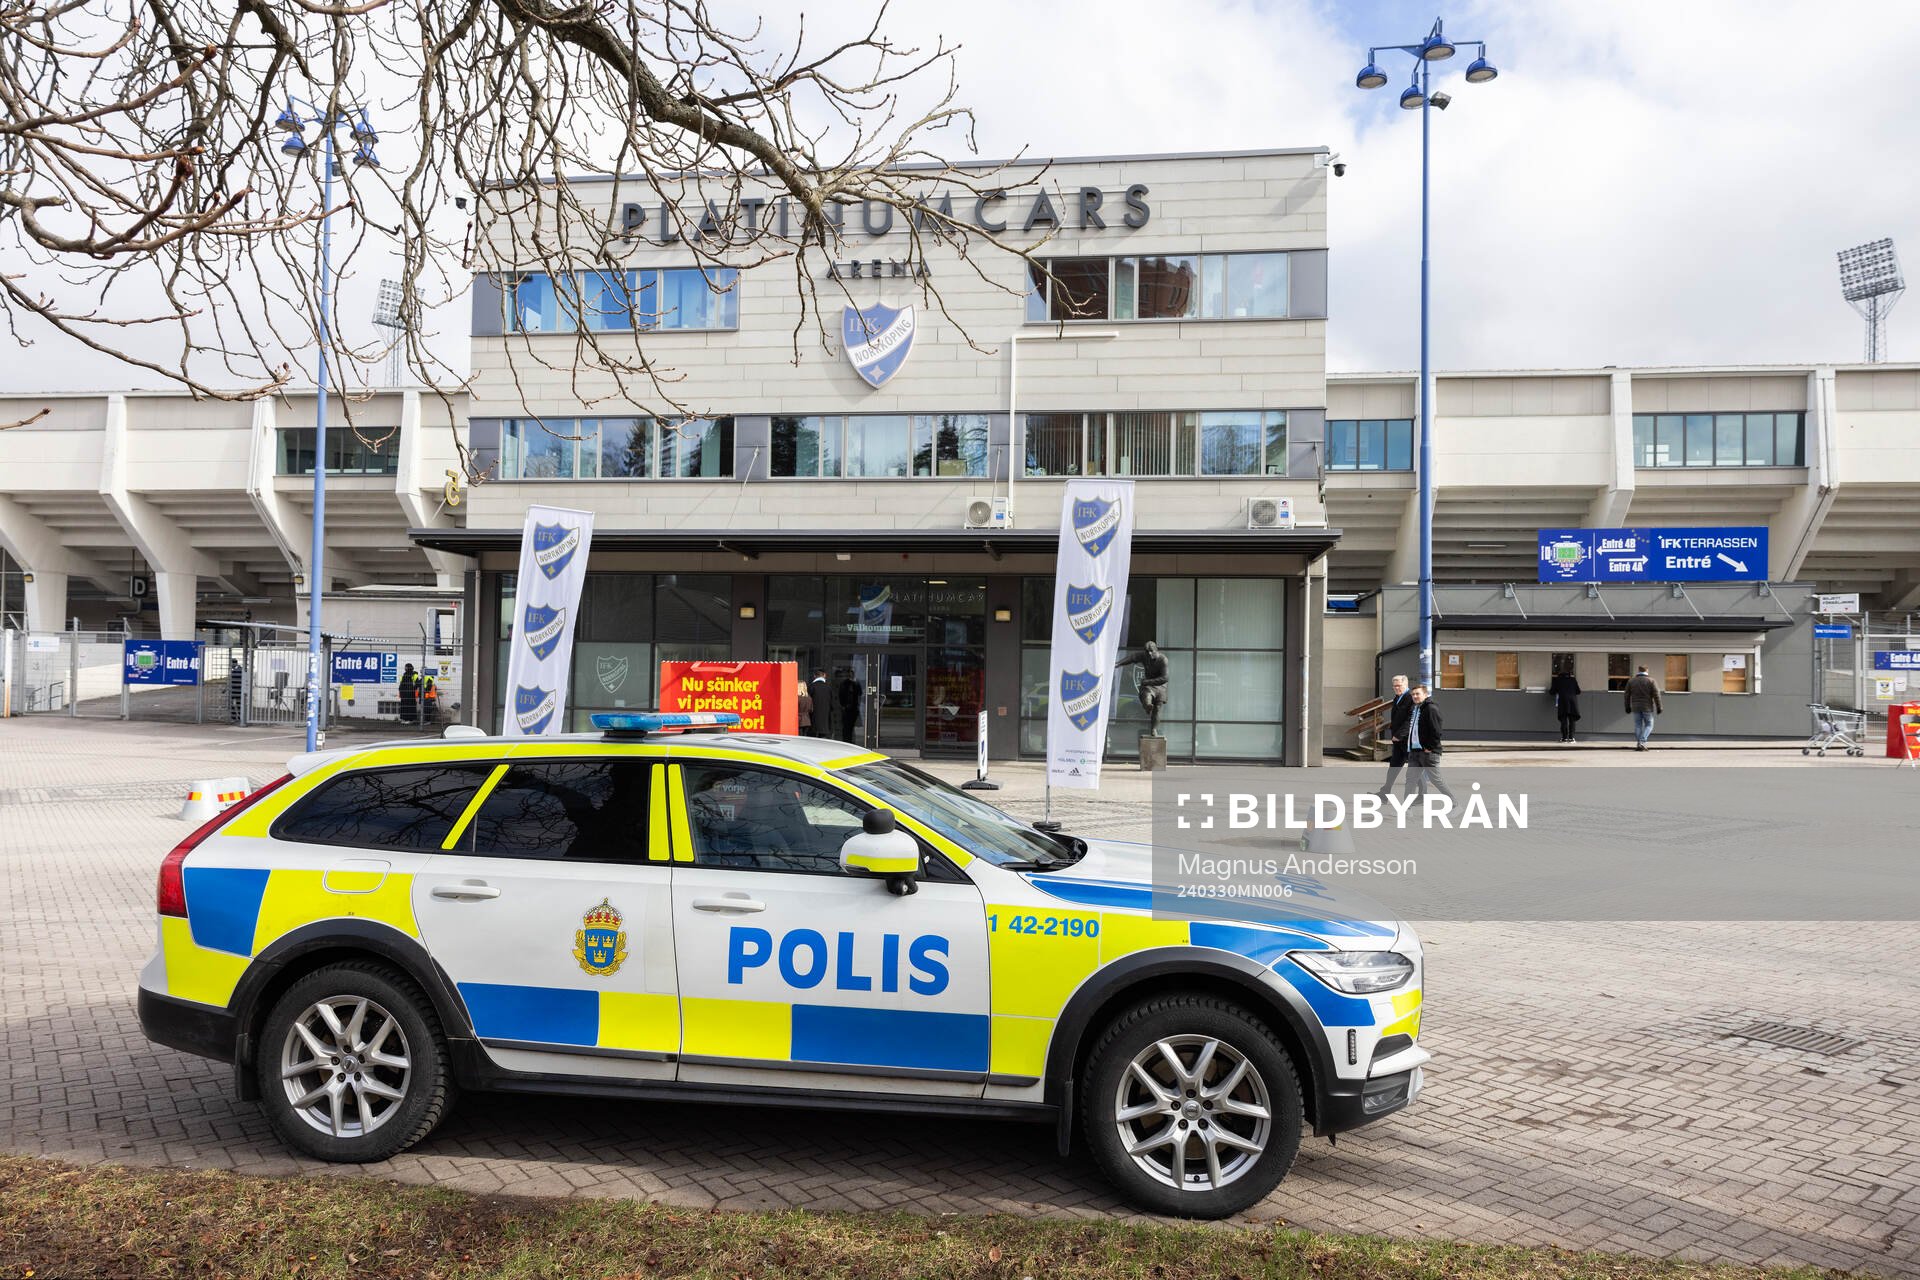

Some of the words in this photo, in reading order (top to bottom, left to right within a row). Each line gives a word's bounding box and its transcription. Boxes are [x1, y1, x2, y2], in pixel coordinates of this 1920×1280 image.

[622, 183, 1151, 244] PLATINUMCARS
[826, 257, 932, 280] ARENA
[849, 317, 879, 333] IFK
[1602, 538, 1623, 549] Entré
[1624, 538, 1636, 549] 4B
[1609, 561, 1631, 573] Entré
[1632, 562, 1643, 572] 4A
[1665, 555, 1712, 569] Entré
[134, 580, 146, 595] D
[846, 623, 904, 632] Välkommen
[166, 656, 189, 670] Entré
[335, 656, 362, 670] Entré
[364, 656, 378, 670] 4B
[385, 654, 395, 667] P
[681, 676, 704, 692] Nu
[706, 676, 760, 692] sänker
[1064, 679, 1086, 691] IFK
[677, 694, 692, 710] vi
[694, 694, 739, 713] priset
[741, 694, 763, 714] på
[1009, 915, 1100, 938] 42-2190
[727, 926, 950, 996] POLIS
